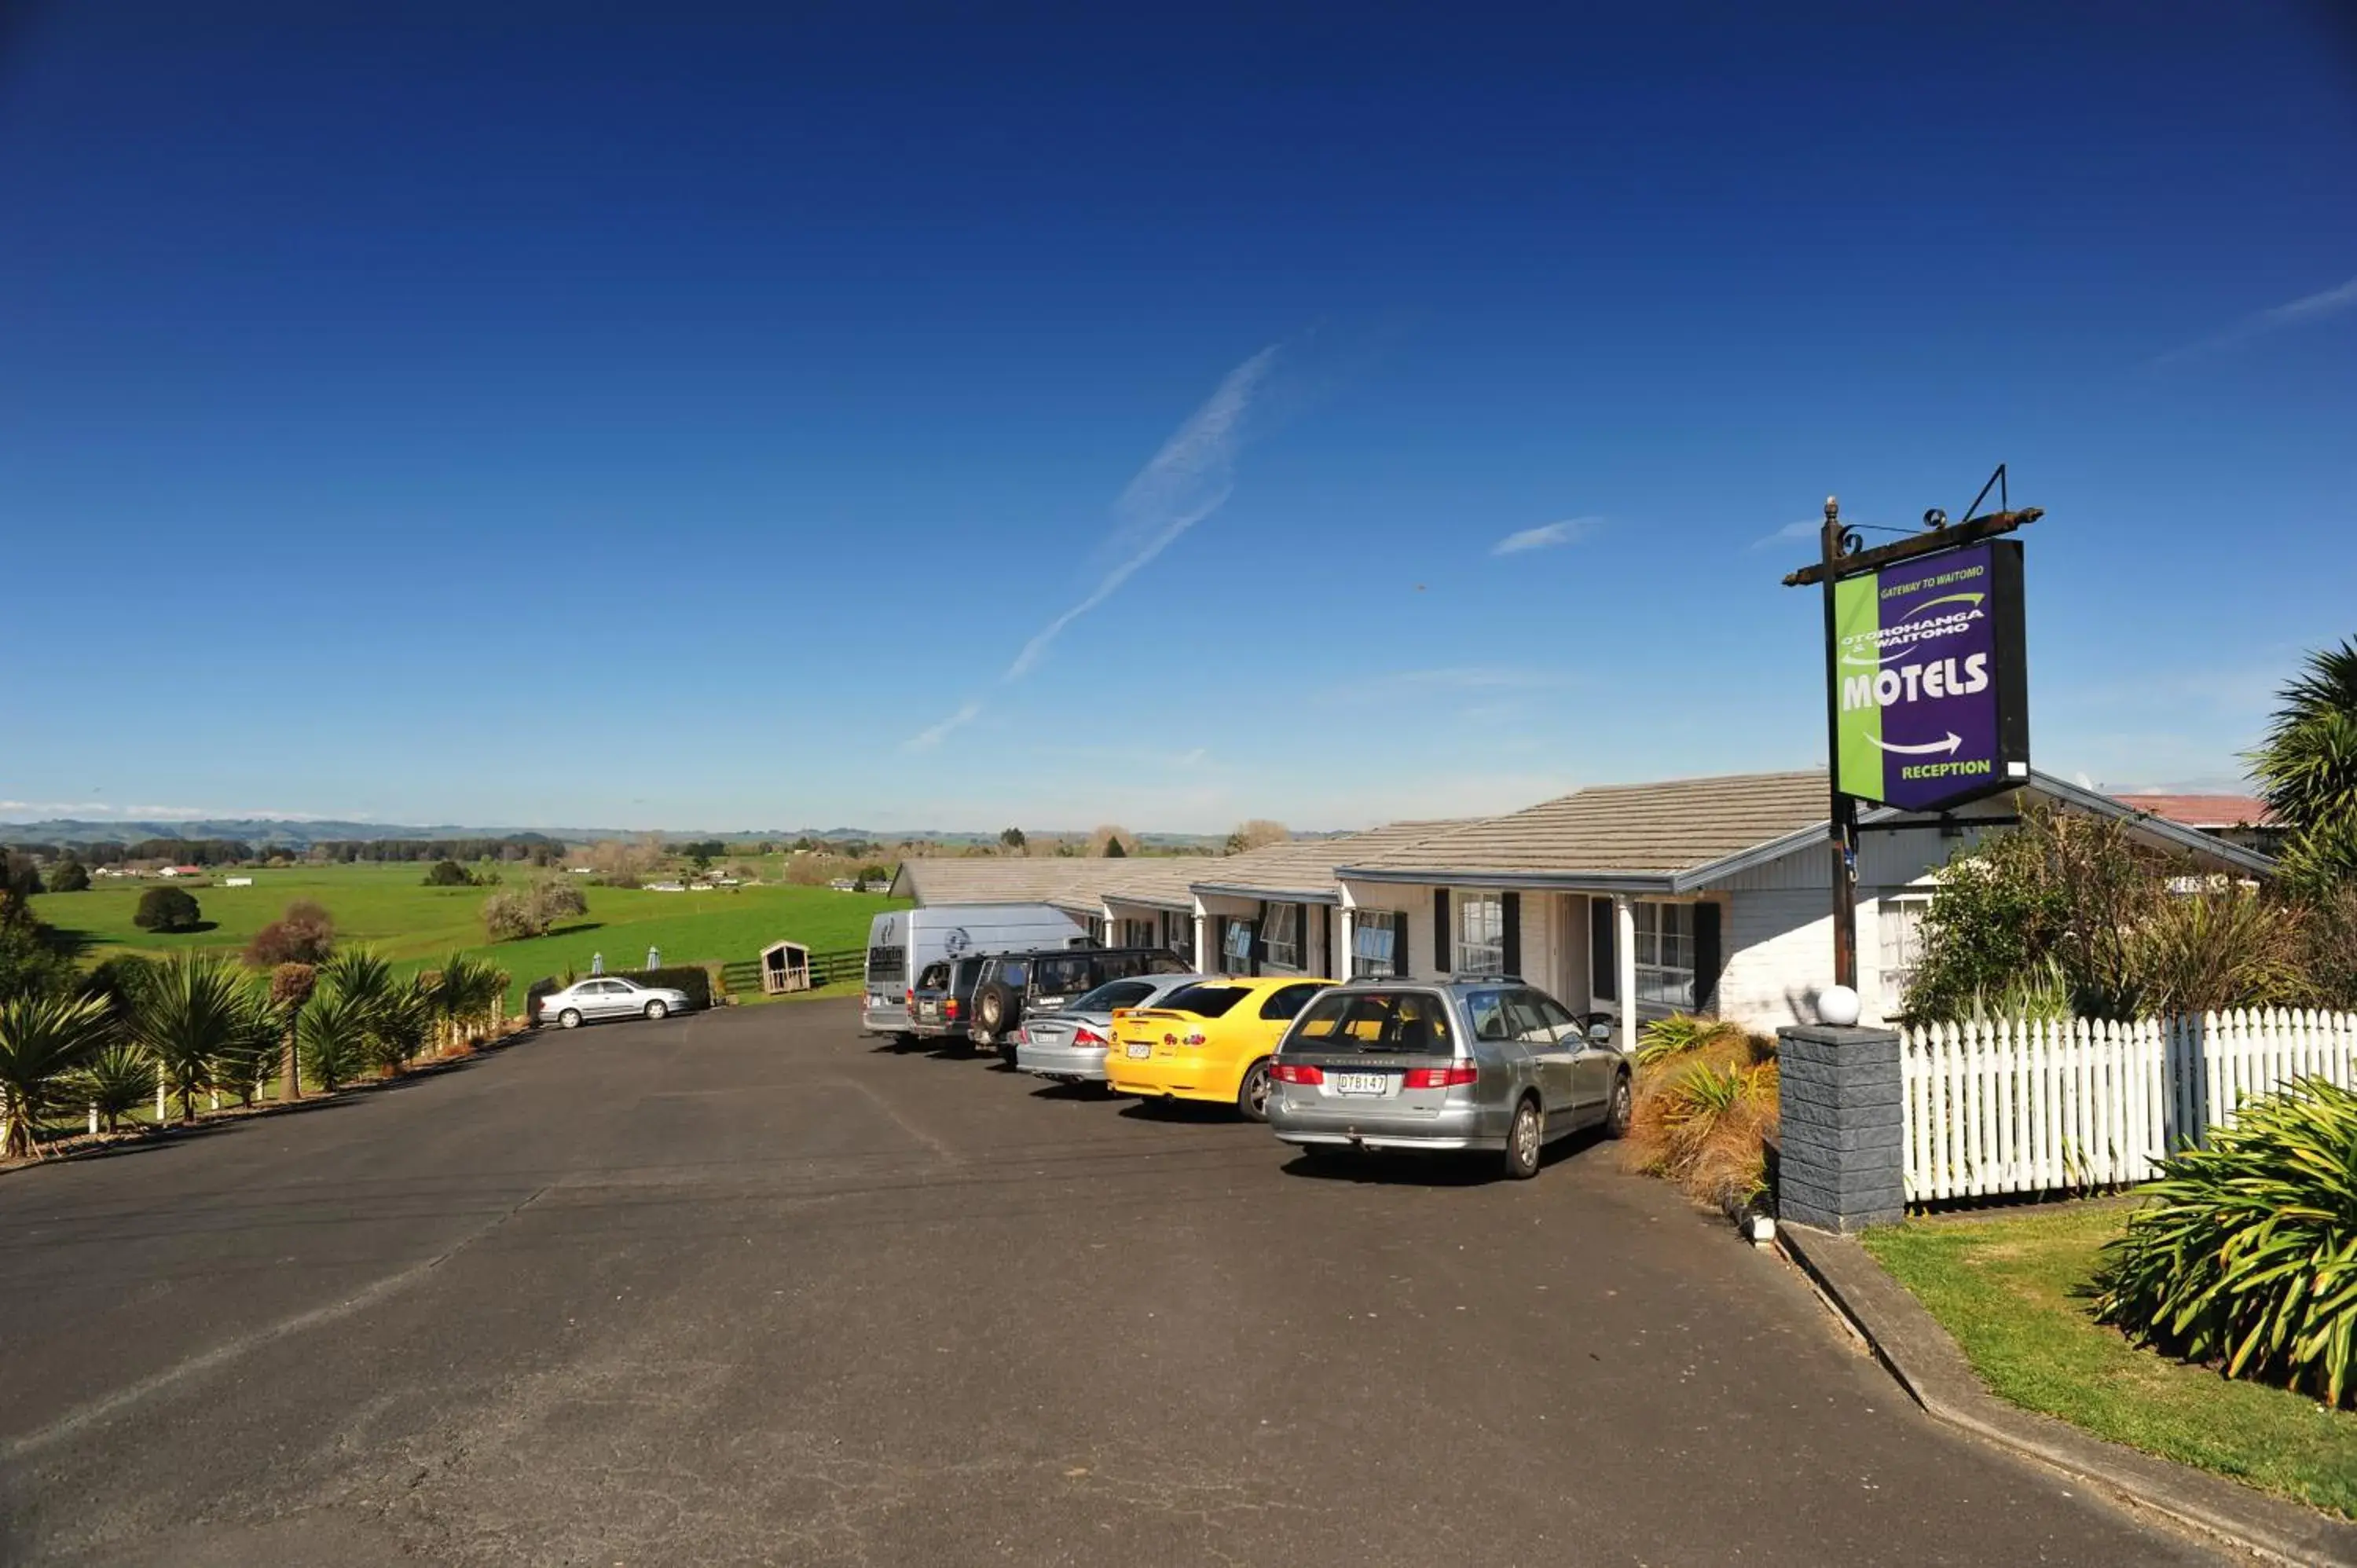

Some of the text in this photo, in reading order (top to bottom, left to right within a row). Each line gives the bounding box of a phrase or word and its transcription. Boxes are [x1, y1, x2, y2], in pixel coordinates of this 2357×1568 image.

[1880, 565, 1985, 599] GATEWAY TO WAITOMO
[1841, 609, 1985, 645] OTOROHANGA
[1853, 622, 1970, 653] & WAITOMO
[1842, 652, 1989, 712] MOTELS
[1901, 759, 1992, 780] RECEPTION
